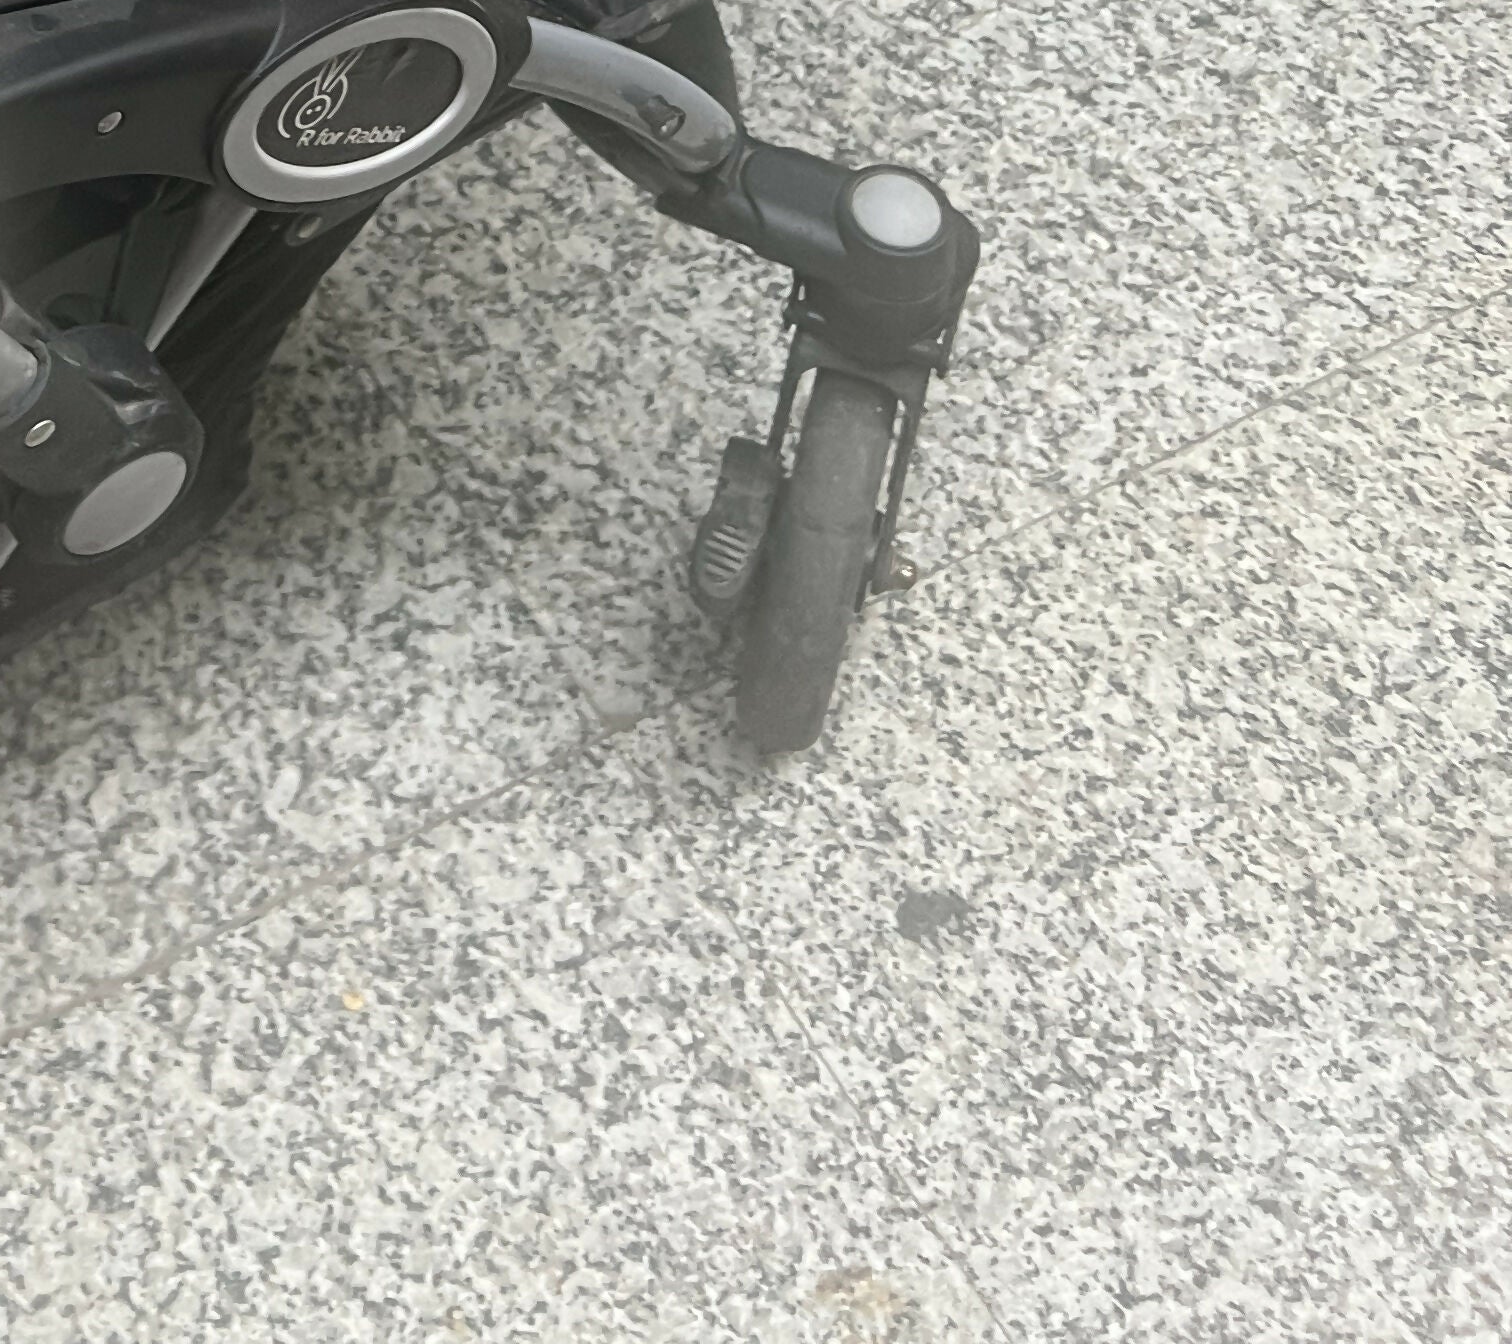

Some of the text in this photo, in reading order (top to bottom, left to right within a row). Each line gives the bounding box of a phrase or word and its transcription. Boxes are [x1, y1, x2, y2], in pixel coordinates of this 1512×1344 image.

[295, 125, 406, 148] R for Rabbit
